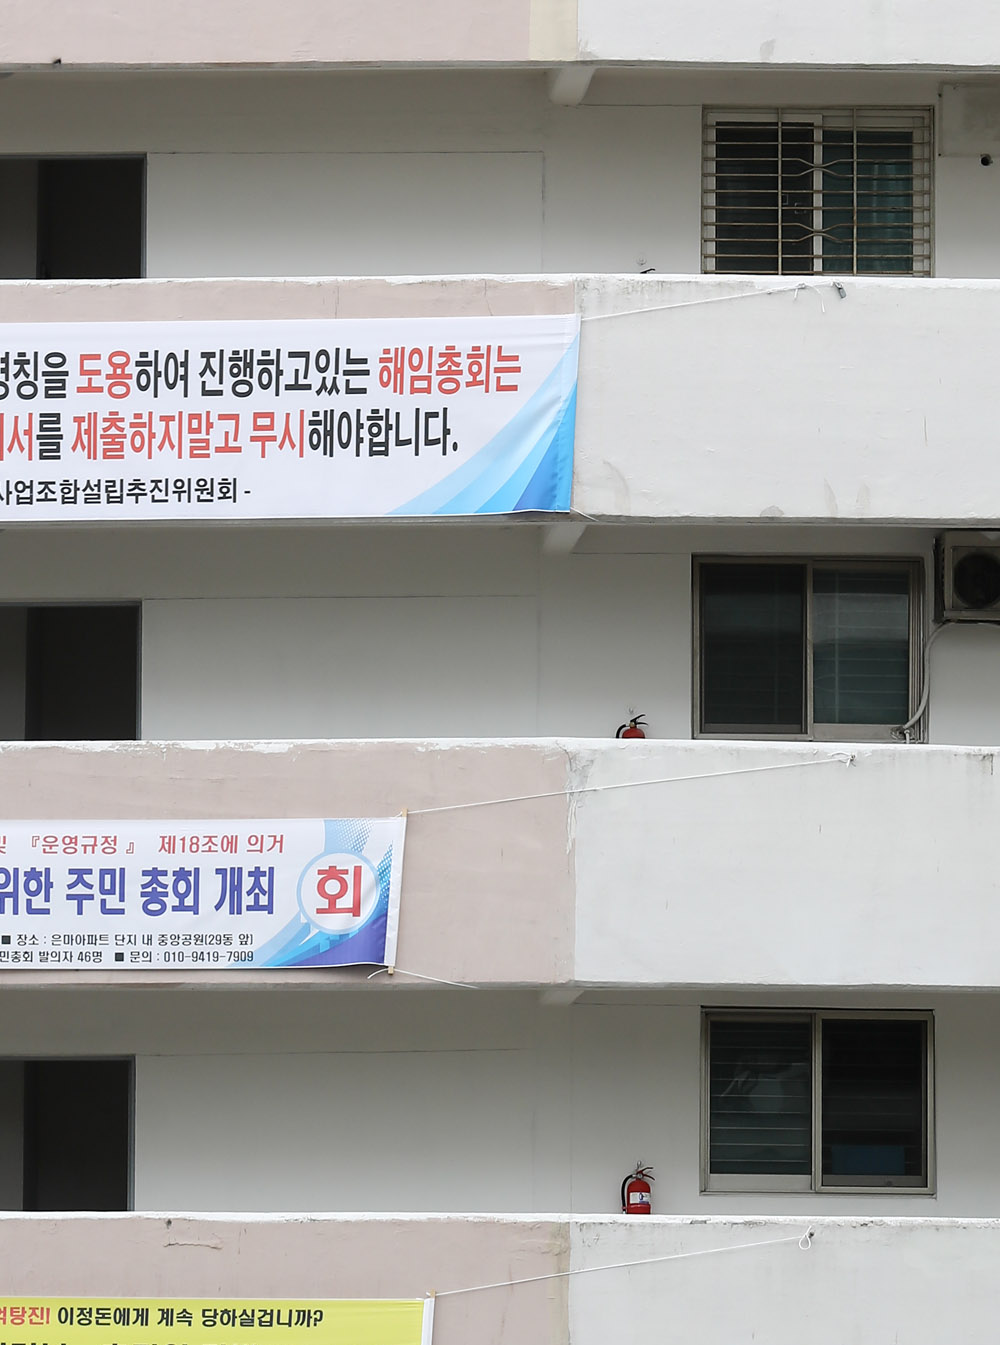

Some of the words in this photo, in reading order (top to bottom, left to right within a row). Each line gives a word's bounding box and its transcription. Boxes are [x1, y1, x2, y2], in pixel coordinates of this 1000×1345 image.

[77, 350, 189, 399] 도용하여
[199, 348, 370, 397] 진행하고있는
[379, 345, 521, 395] 해임총회는
[71, 411, 242, 460] 제출하지말고
[250, 407, 458, 458] 무시해야합니다.
[159, 835, 238, 854] 제18조에
[247, 835, 283, 853] 의거
[66, 868, 125, 915] 주민
[140, 867, 200, 916] 총회
[214, 866, 274, 915] 개최
[316, 866, 362, 917] 회
[17, 934, 39, 946] 장소
[52, 934, 109, 946] 은마아파트
[115, 934, 136, 946] 단지
[142, 934, 152, 945] 내
[158, 934, 233, 946] 중앙공원(29동
[239, 934, 253, 945] 앞)
[39, 951, 73, 962] 발의자
[78, 951, 102, 963] 46명
[130, 951, 152, 963] 문의
[164, 951, 253, 962] 010-9419-7909
[58, 1307, 149, 1326] 이정돈에게
[157, 1308, 192, 1326] 계속
[202, 1309, 323, 1327] 당하실겁니까?
